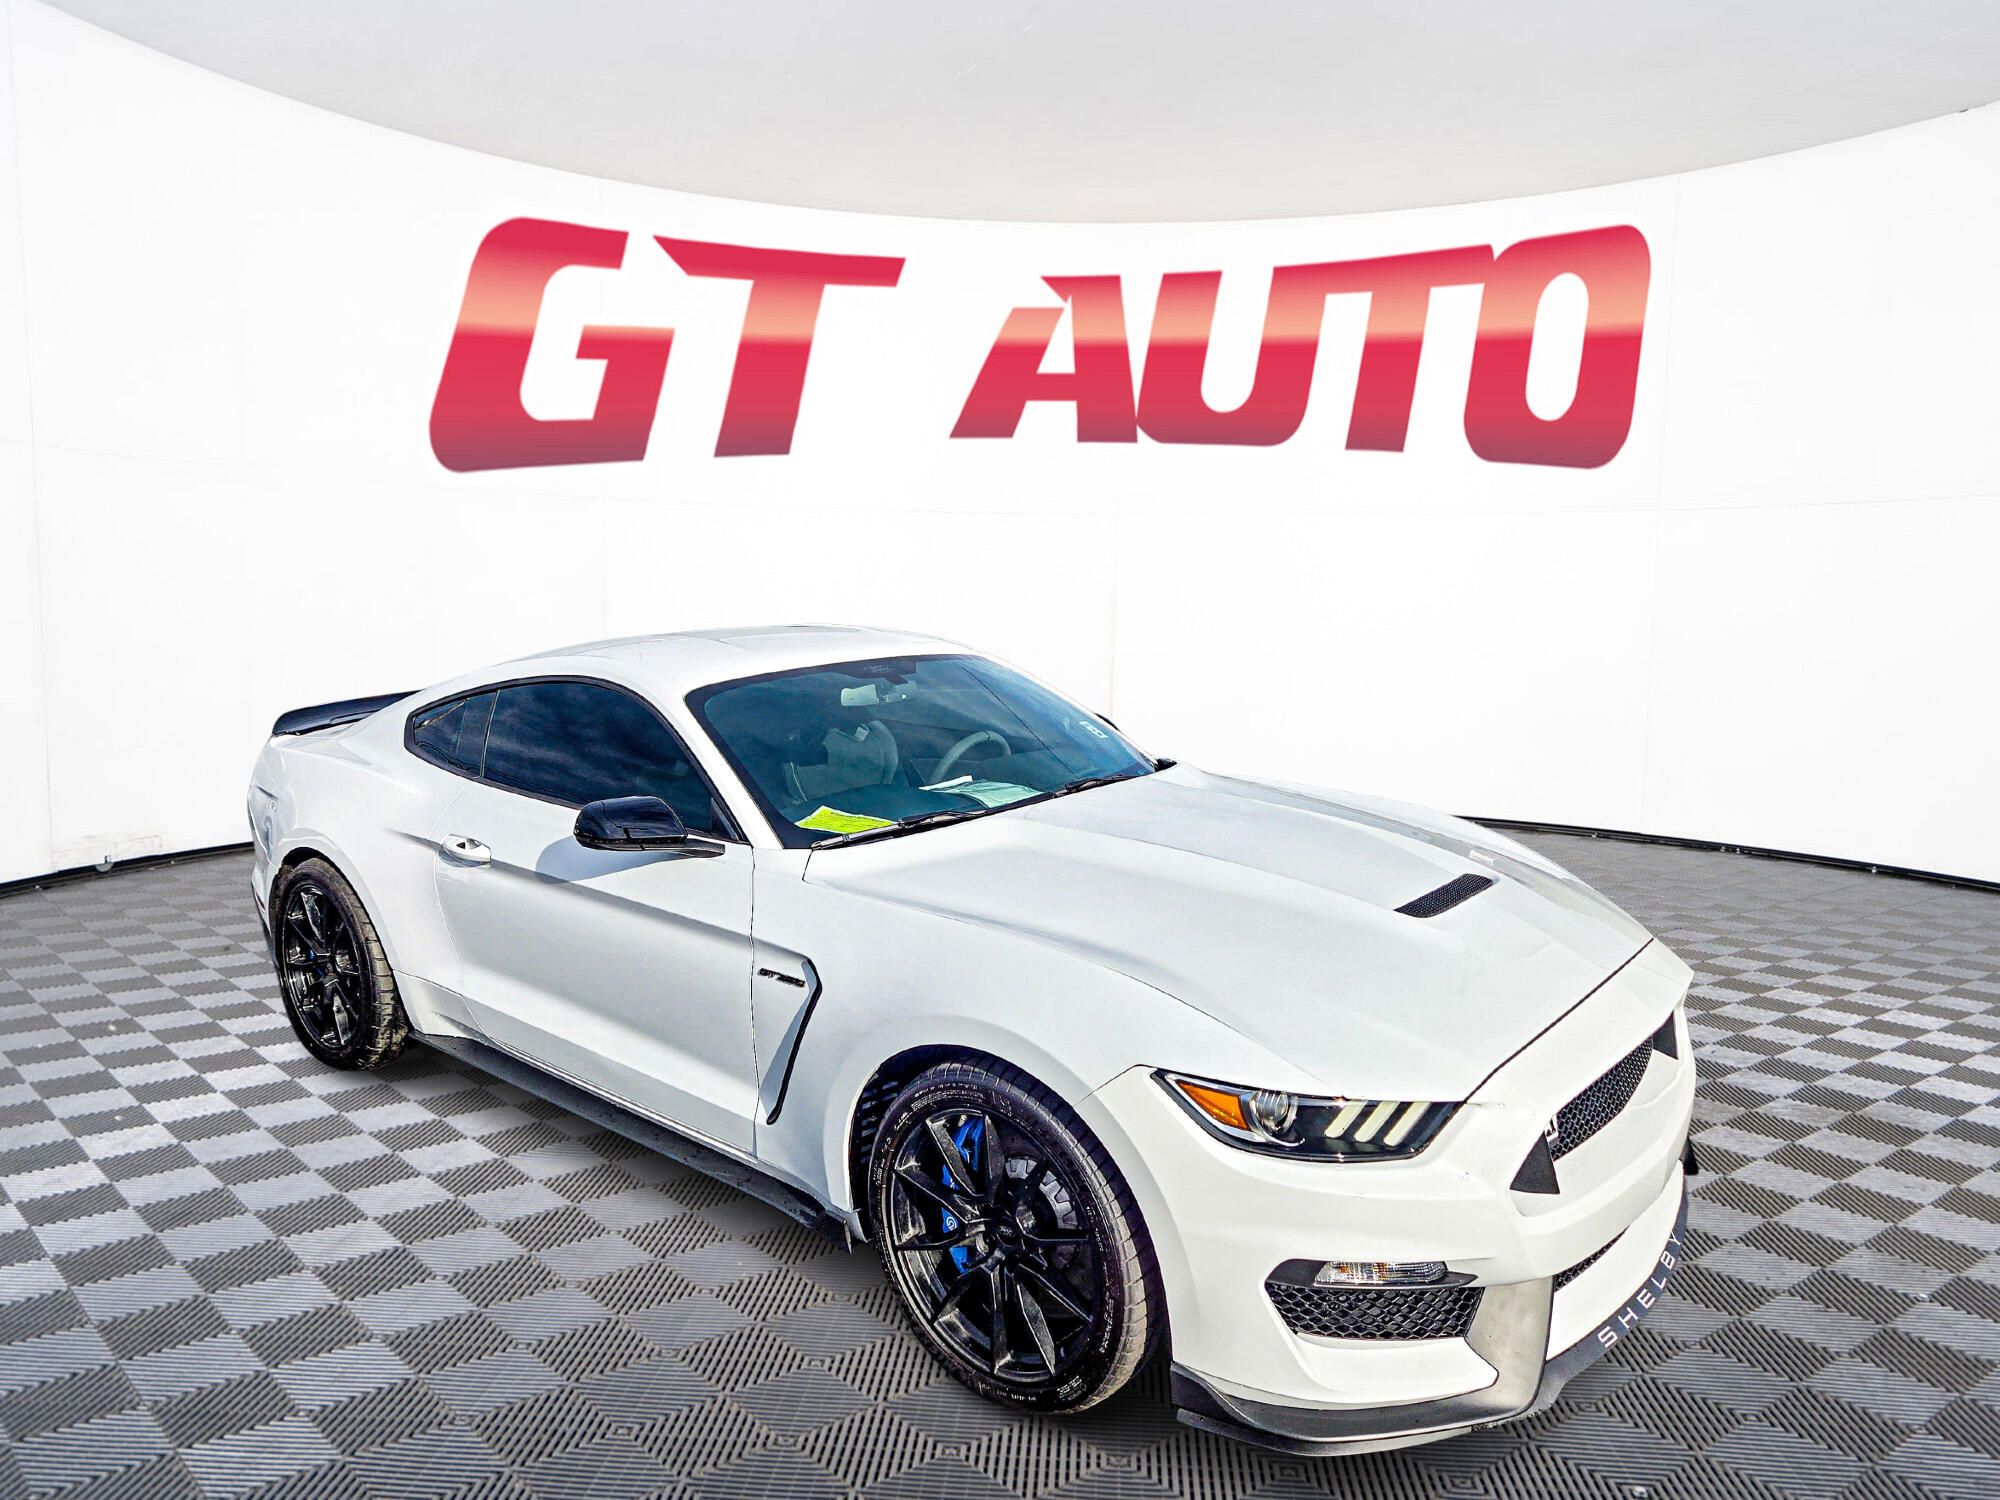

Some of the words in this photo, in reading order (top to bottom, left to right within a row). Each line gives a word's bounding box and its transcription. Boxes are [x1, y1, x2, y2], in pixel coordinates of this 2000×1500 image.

[429, 217, 906, 472] GT
[951, 225, 1650, 468] AUTO
[1597, 1232, 1681, 1348] SHELBY
